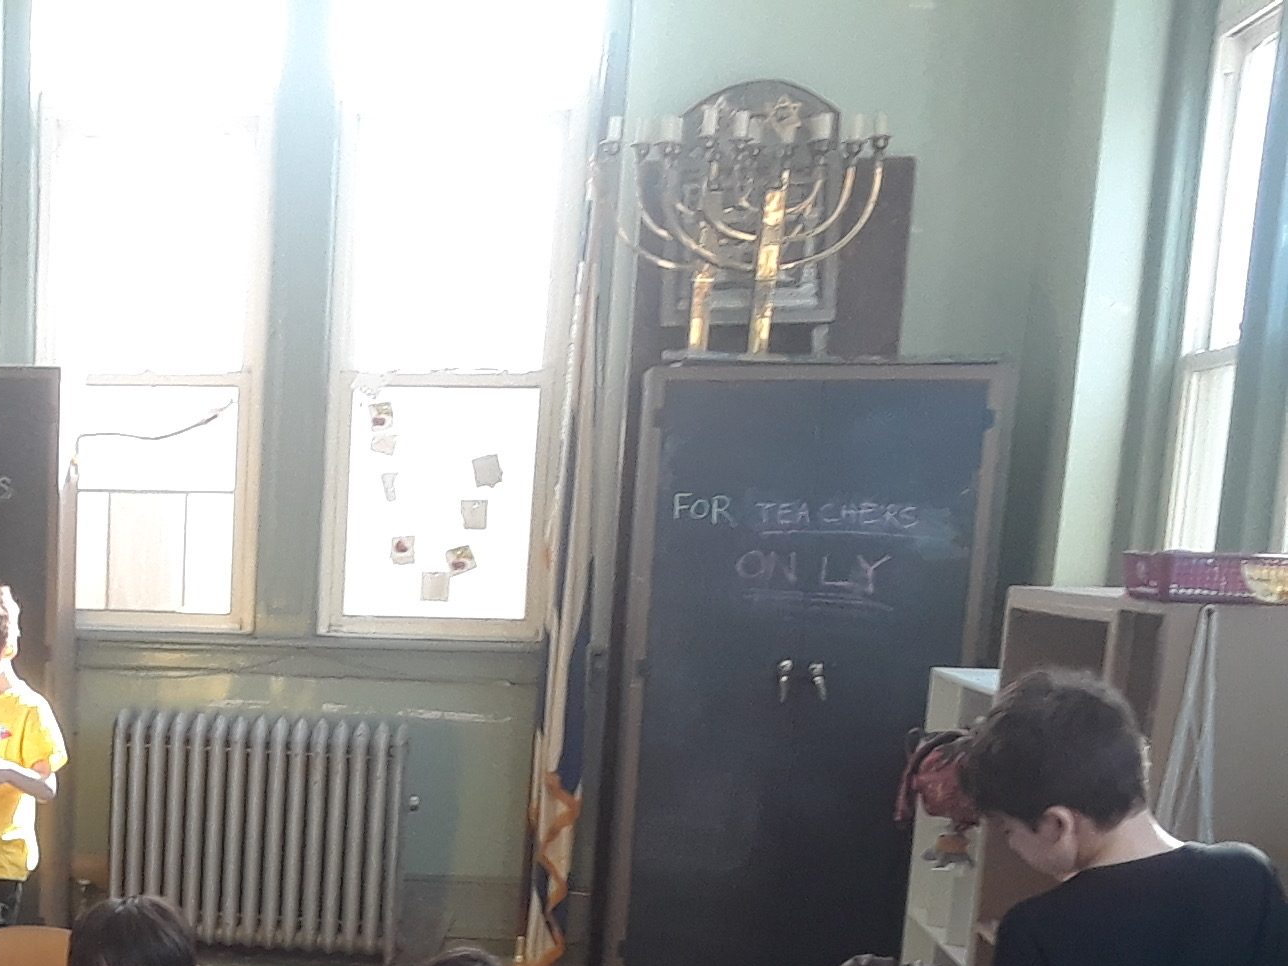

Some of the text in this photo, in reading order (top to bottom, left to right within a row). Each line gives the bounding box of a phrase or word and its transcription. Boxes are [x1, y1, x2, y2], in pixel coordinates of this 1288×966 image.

[672, 492, 919, 530] FOR TEACHERS
[735, 549, 893, 596] ONLY
